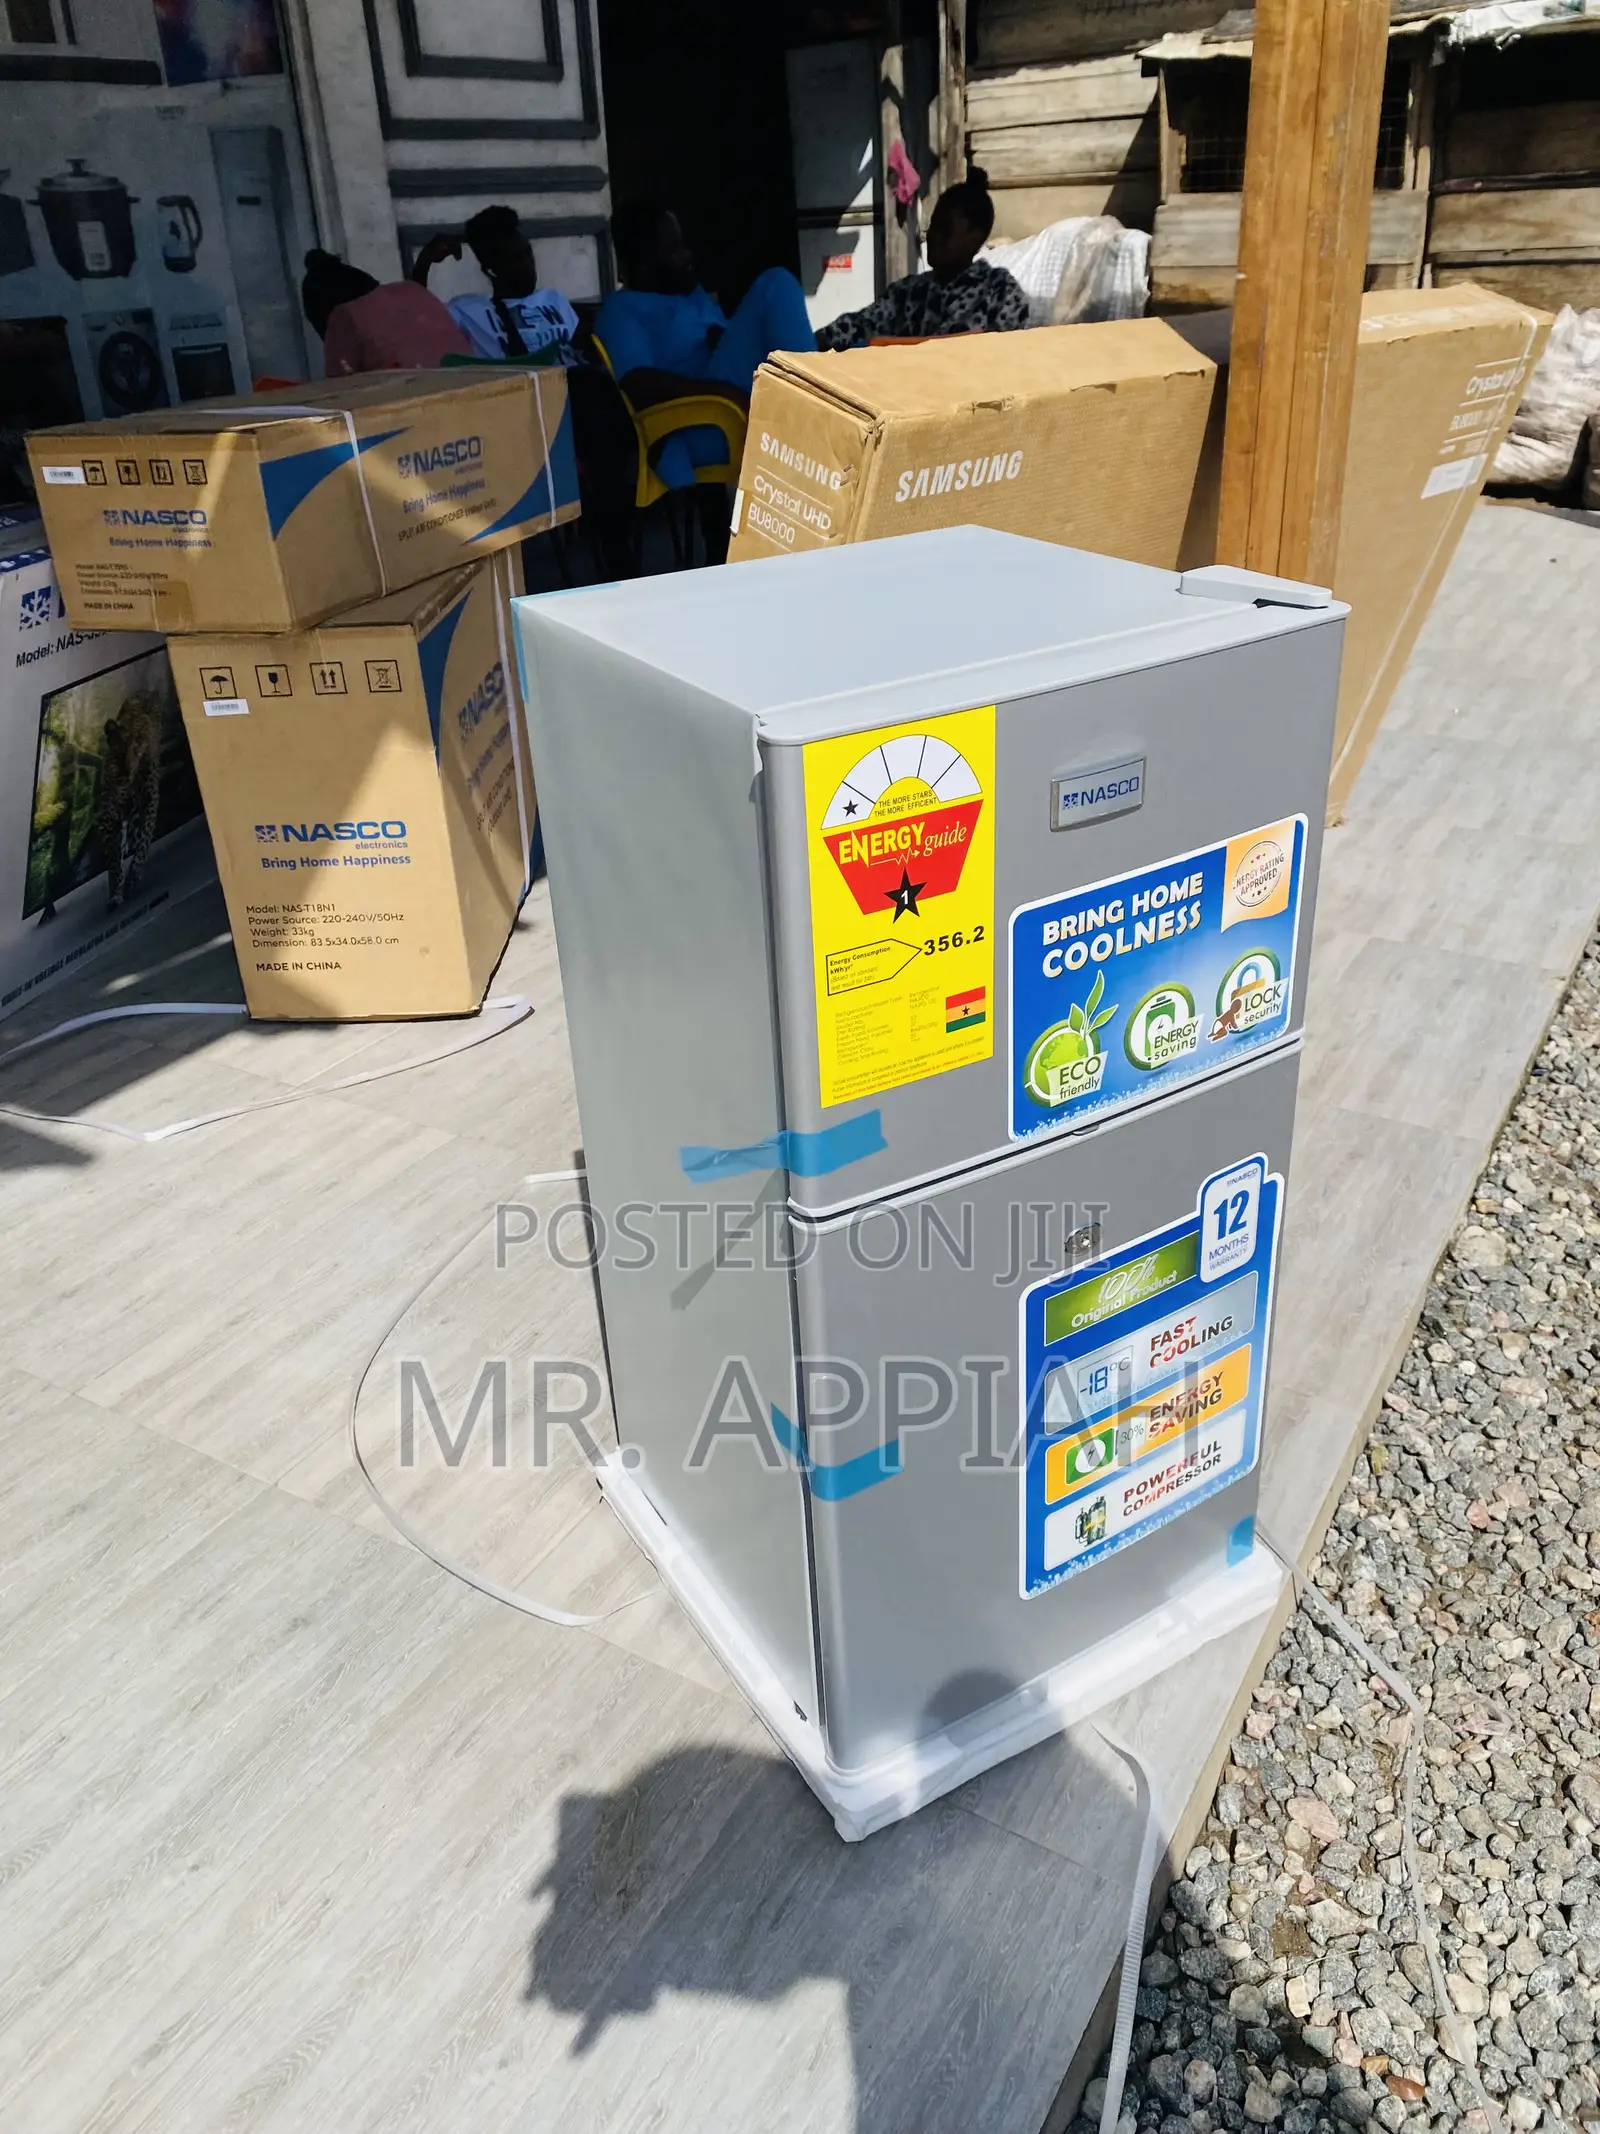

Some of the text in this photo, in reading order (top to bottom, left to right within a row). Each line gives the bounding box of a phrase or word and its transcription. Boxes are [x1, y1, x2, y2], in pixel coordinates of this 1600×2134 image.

[413, 435, 482, 475] NASCO
[760, 432, 842, 491] SAMSUNG
[895, 450, 1023, 502] SAMSUNG
[426, 488, 448, 507] Home
[754, 475, 831, 530] Crystal UHD
[121, 509, 207, 525] NASCO
[749, 503, 795, 544] BU8000
[16, 643, 54, 668] Model:
[879, 790, 933, 808] THE MORE STARS
[1081, 776, 1139, 806] NASCO
[875, 797, 937, 818] THE MORE EFFICIENT
[281, 821, 407, 842] NASCO
[355, 841, 408, 850] electronics
[838, 821, 967, 867] ENERGY guide
[261, 855, 411, 870] Bring Home Happiness
[1260, 853, 1284, 873] RATING
[1241, 868, 1278, 896] APPROVED
[246, 903, 336, 914] Model: NAS-T18N1
[901, 890, 909, 905] 1
[1042, 872, 1204, 946] BRING HOME
[248, 913, 404, 925] Power Source: 220-240V/50Hz
[250, 927, 315, 937] Weight: 33kg
[252, 939, 307, 948] Dimension:
[385, 937, 399, 945] cm
[923, 926, 985, 956] 356.2
[1042, 900, 1202, 978] COOLNESS
[256, 961, 342, 971] MADE IN CHINA
[830, 947, 891, 966] Energy Consumption
[1244, 983, 1282, 1013] LOCK
[1244, 1001, 1282, 1025] security
[1154, 1019, 1199, 1049] ENERGY
[1154, 1036, 1197, 1061] saving
[1059, 1056, 1101, 1086] ECO
[1059, 1077, 1101, 1099] friendly
[1231, 1168, 1258, 1185] NASCO
[1213, 1190, 1250, 1240] 12
[1209, 1233, 1249, 1261] MONTHS
[1209, 1248, 1248, 1271] WARRANTY
[1098, 1253, 1159, 1303] 100%
[1071, 1271, 1177, 1328] Original Product
[1150, 1316, 1197, 1351] FAST
[1150, 1315, 1233, 1368] COOLING
[1150, 1372, 1223, 1422] ENERGY
[1149, 1389, 1222, 1438] SAVING
[1120, 1423, 1144, 1444] 30%
[1123, 1440, 1222, 1503] POWERFUL
[1123, 1453, 1222, 1517] COMPRESSOR
